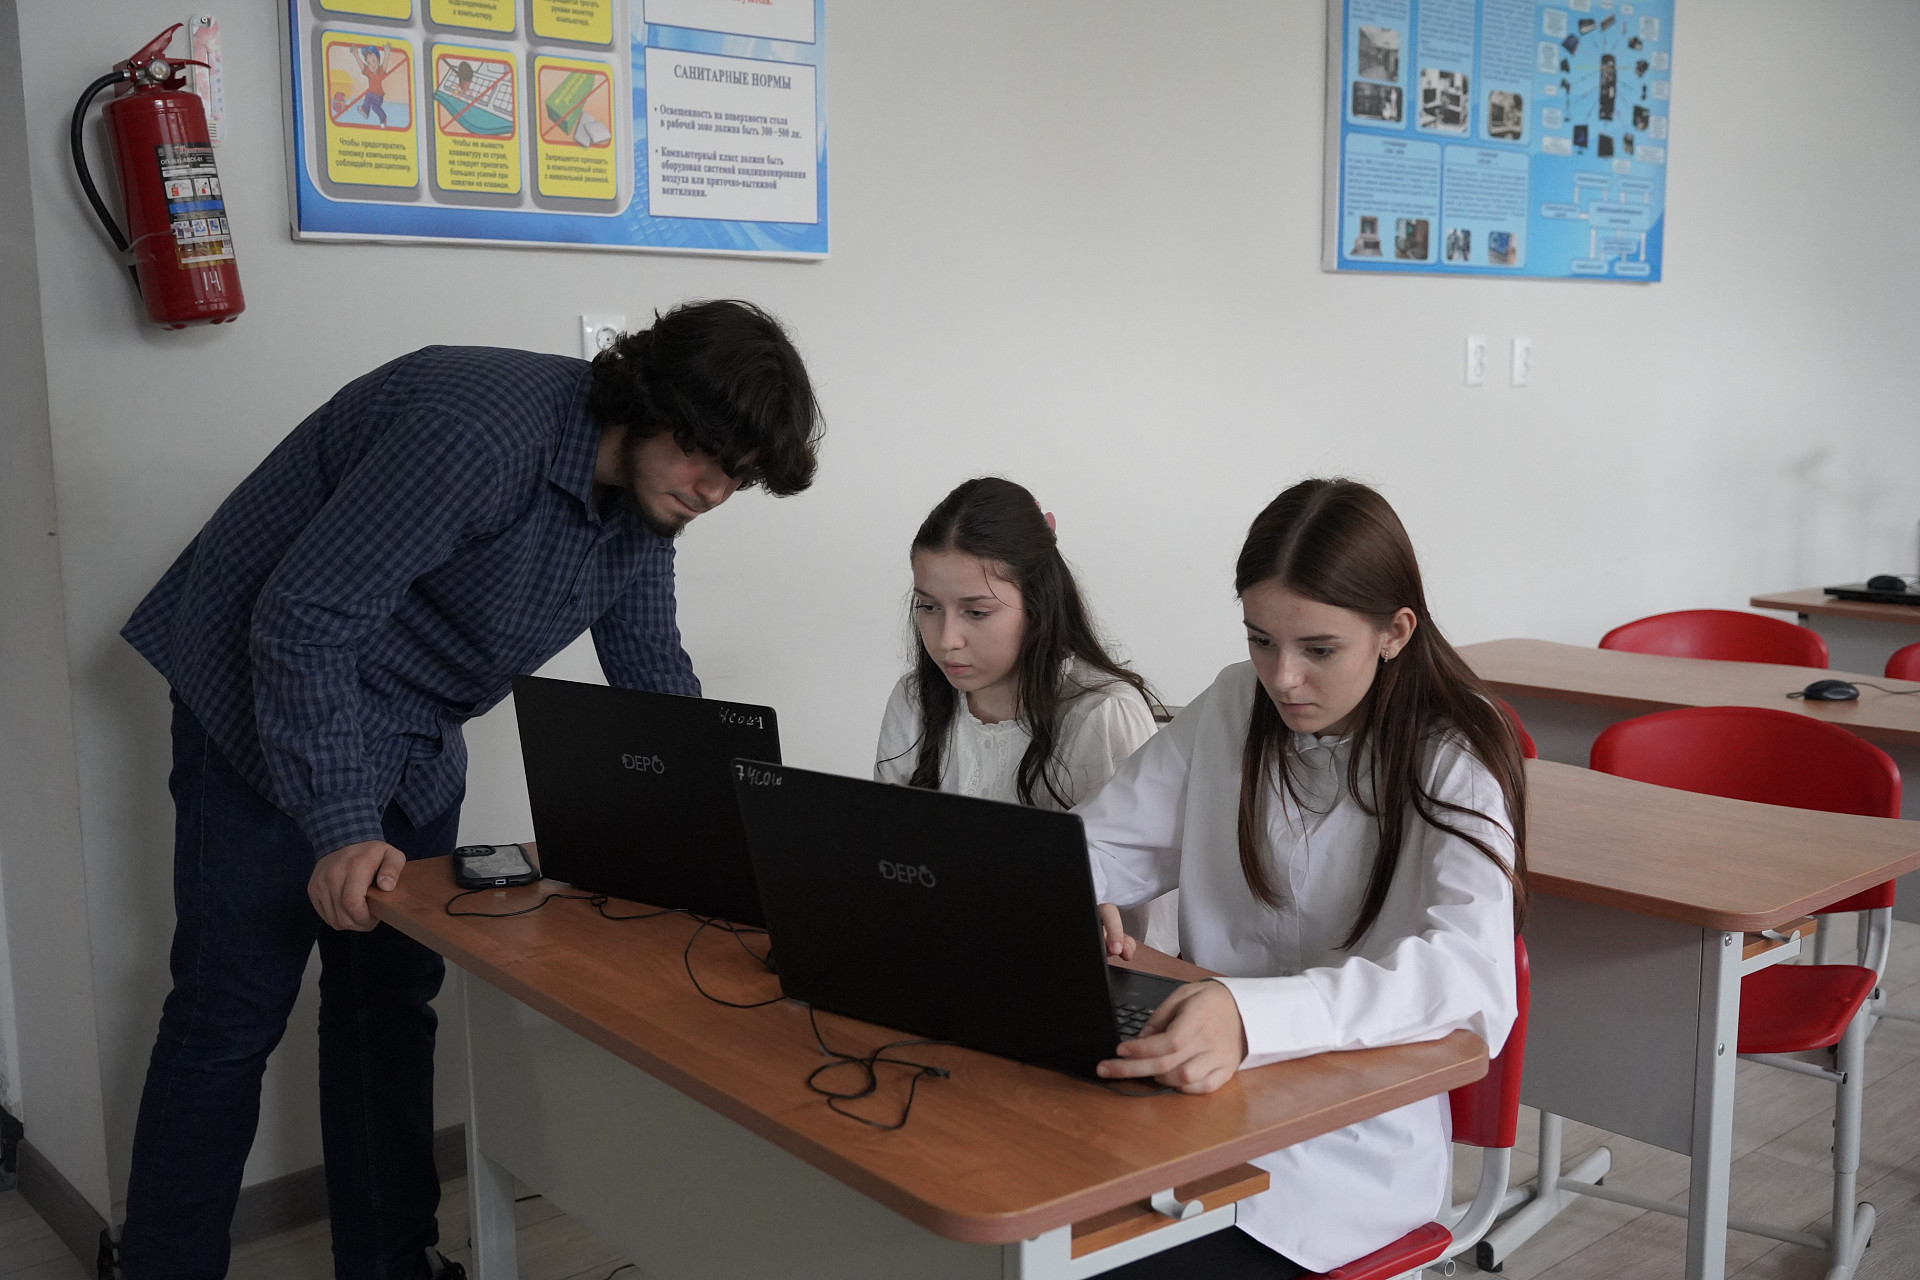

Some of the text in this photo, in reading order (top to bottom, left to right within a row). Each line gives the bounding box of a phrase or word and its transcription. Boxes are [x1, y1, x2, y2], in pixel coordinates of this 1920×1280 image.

[674, 64, 791, 90] САНИТАРНЫЕ НОРМЫ
[714, 112, 722, 120] на
[725, 112, 767, 124] поверхности
[769, 117, 788, 125] стола
[660, 119, 664, 127] в
[667, 119, 695, 130] рабочей
[698, 124, 712, 132] зоне
[714, 125, 740, 134] должна
[742, 125, 759, 136] быть
[761, 126, 772, 136] 300
[778, 128, 790, 138] 500
[339, 138, 406, 150] Чтобы предотвратить
[452, 138, 471, 147] Чтобы
[338, 150, 364, 159] поломку
[449, 150, 482, 159] клавиатуру
[661, 146, 784, 165] Компьютерный класс должен быть
[336, 158, 373, 168] соблюдайте
[456, 160, 479, 168] следует
[450, 168, 475, 176] больших
[476, 171, 496, 179] усилий
[661, 160, 806, 180] оборудован системой кондиционирования
[662, 174, 777, 189] воздуха или приточно-вытяжной
[662, 186, 707, 197] вентиляции.
[203, 271, 222, 291] 14
[622, 753, 665, 774] DEPO
[878, 860, 936, 888] DEPO
